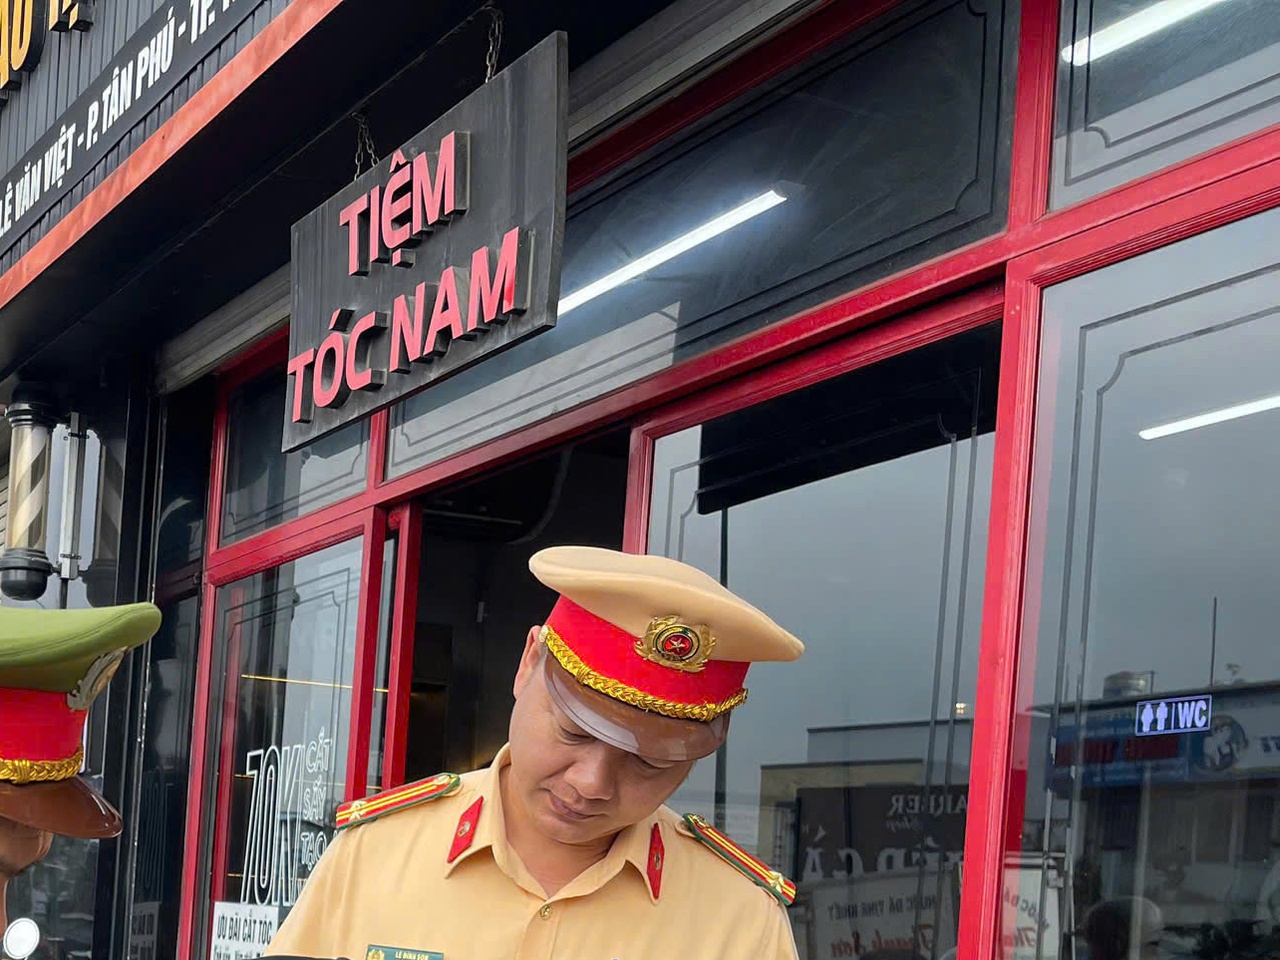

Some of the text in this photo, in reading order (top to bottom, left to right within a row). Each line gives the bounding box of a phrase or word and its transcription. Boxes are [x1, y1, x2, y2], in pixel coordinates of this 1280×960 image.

[14, 162, 42, 222] VĂN
[44, 122, 76, 189] VIỆT
[86, 101, 99, 151] P.
[102, 64, 133, 134] TÂN
[135, 7, 175, 100] PHÚ
[339, 131, 455, 276] TIỆM
[287, 226, 520, 422] TÓC NAM
[1177, 700, 1208, 730] WC
[240, 727, 332, 907] 70K CẮT
[303, 775, 327, 821] SẤY
[228, 912, 241, 942] ĐÃI
[242, 908, 256, 943] CẮT
[258, 913, 272, 945] TÓC
